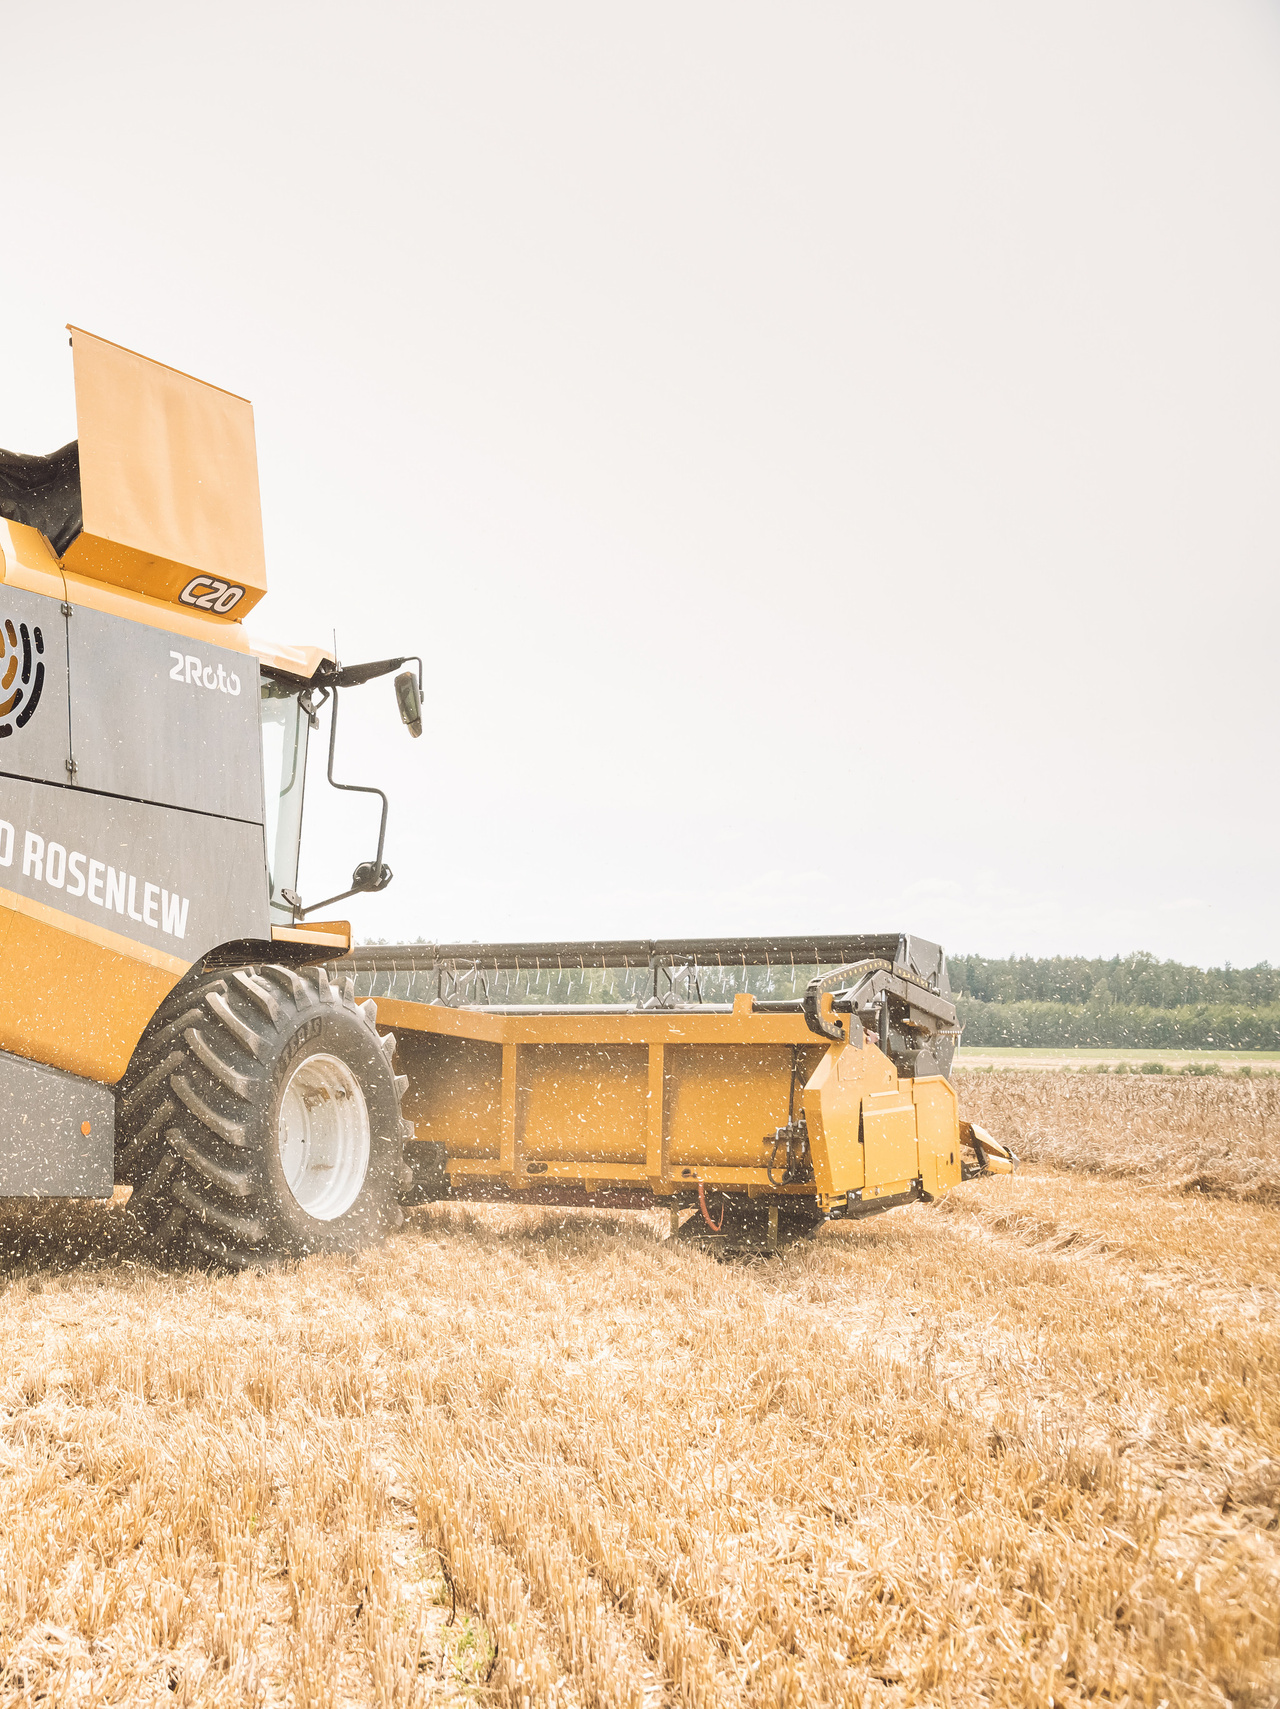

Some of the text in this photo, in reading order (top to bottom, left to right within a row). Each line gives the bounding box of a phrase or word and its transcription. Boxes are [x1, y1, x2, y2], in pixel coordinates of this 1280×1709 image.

[179, 575, 245, 614] C20
[169, 650, 241, 696] 2Roto
[22, 830, 190, 939] ROSENLEW
